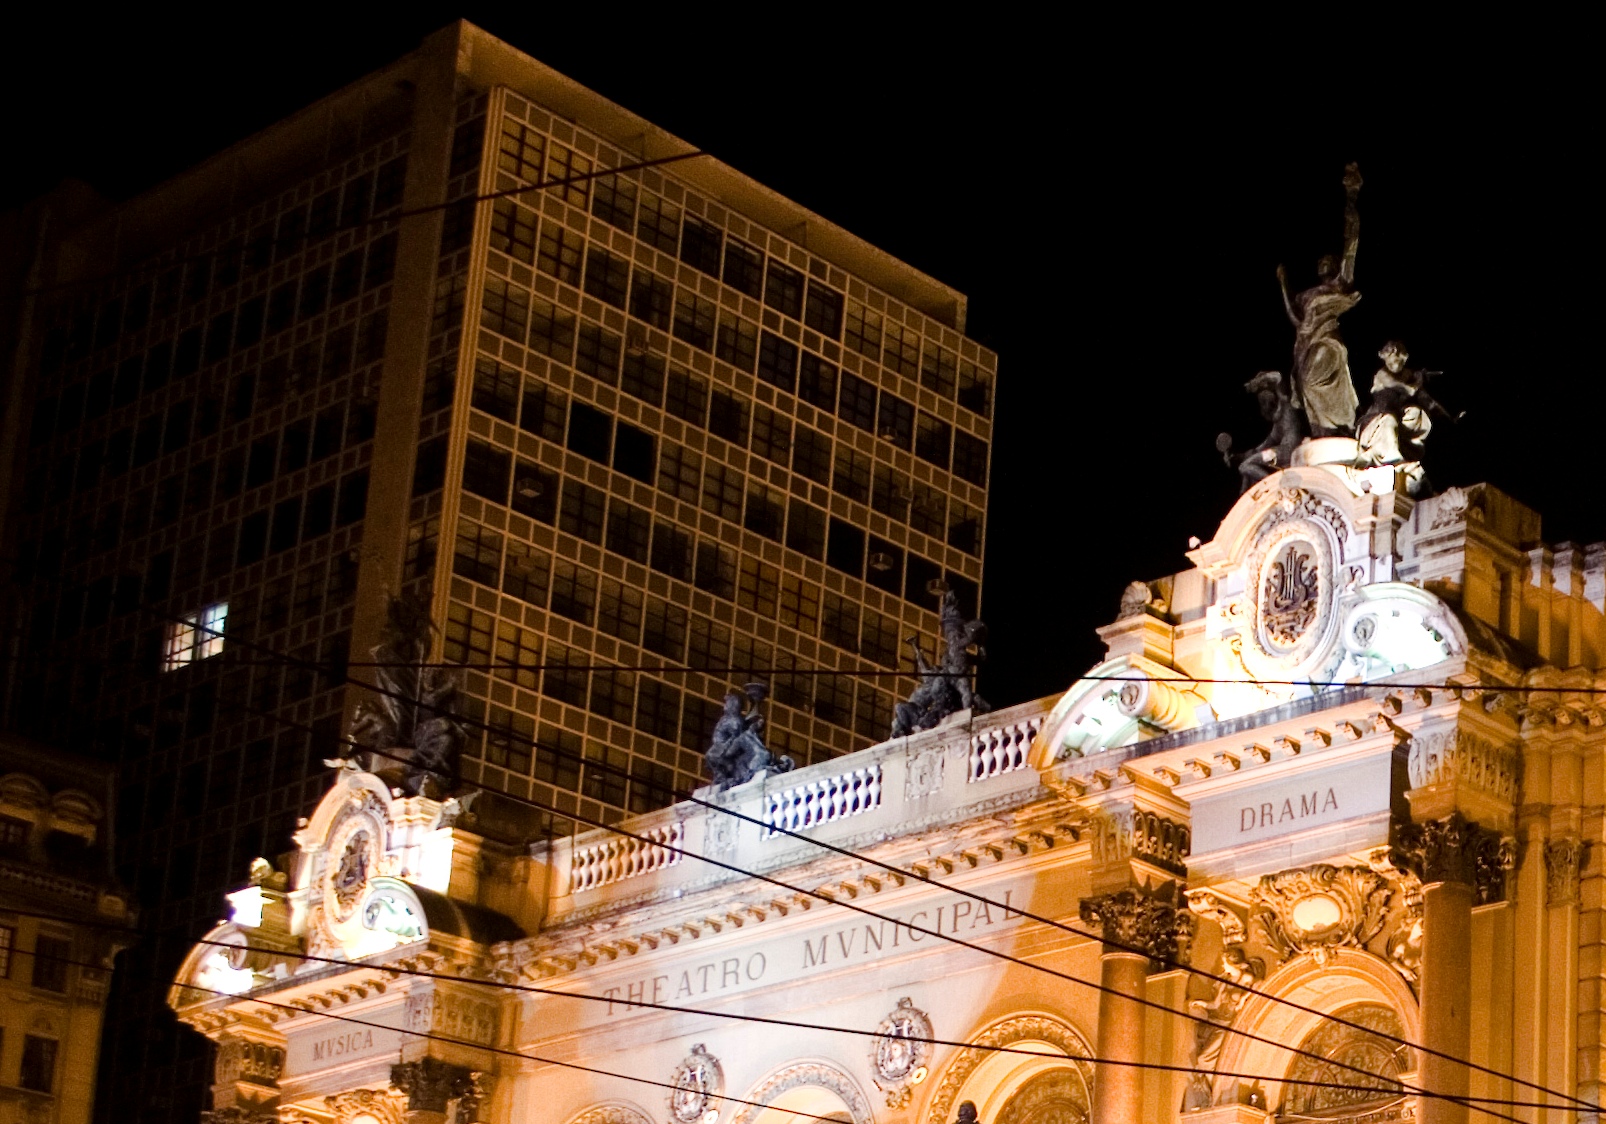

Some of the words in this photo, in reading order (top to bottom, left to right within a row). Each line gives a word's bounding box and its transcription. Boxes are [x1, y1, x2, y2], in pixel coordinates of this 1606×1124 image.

[1240, 787, 1339, 832] DRAMA
[603, 951, 767, 1016] THEATRO
[802, 889, 1025, 969] MVNICIPAL
[312, 1029, 374, 1061] MVSICA
